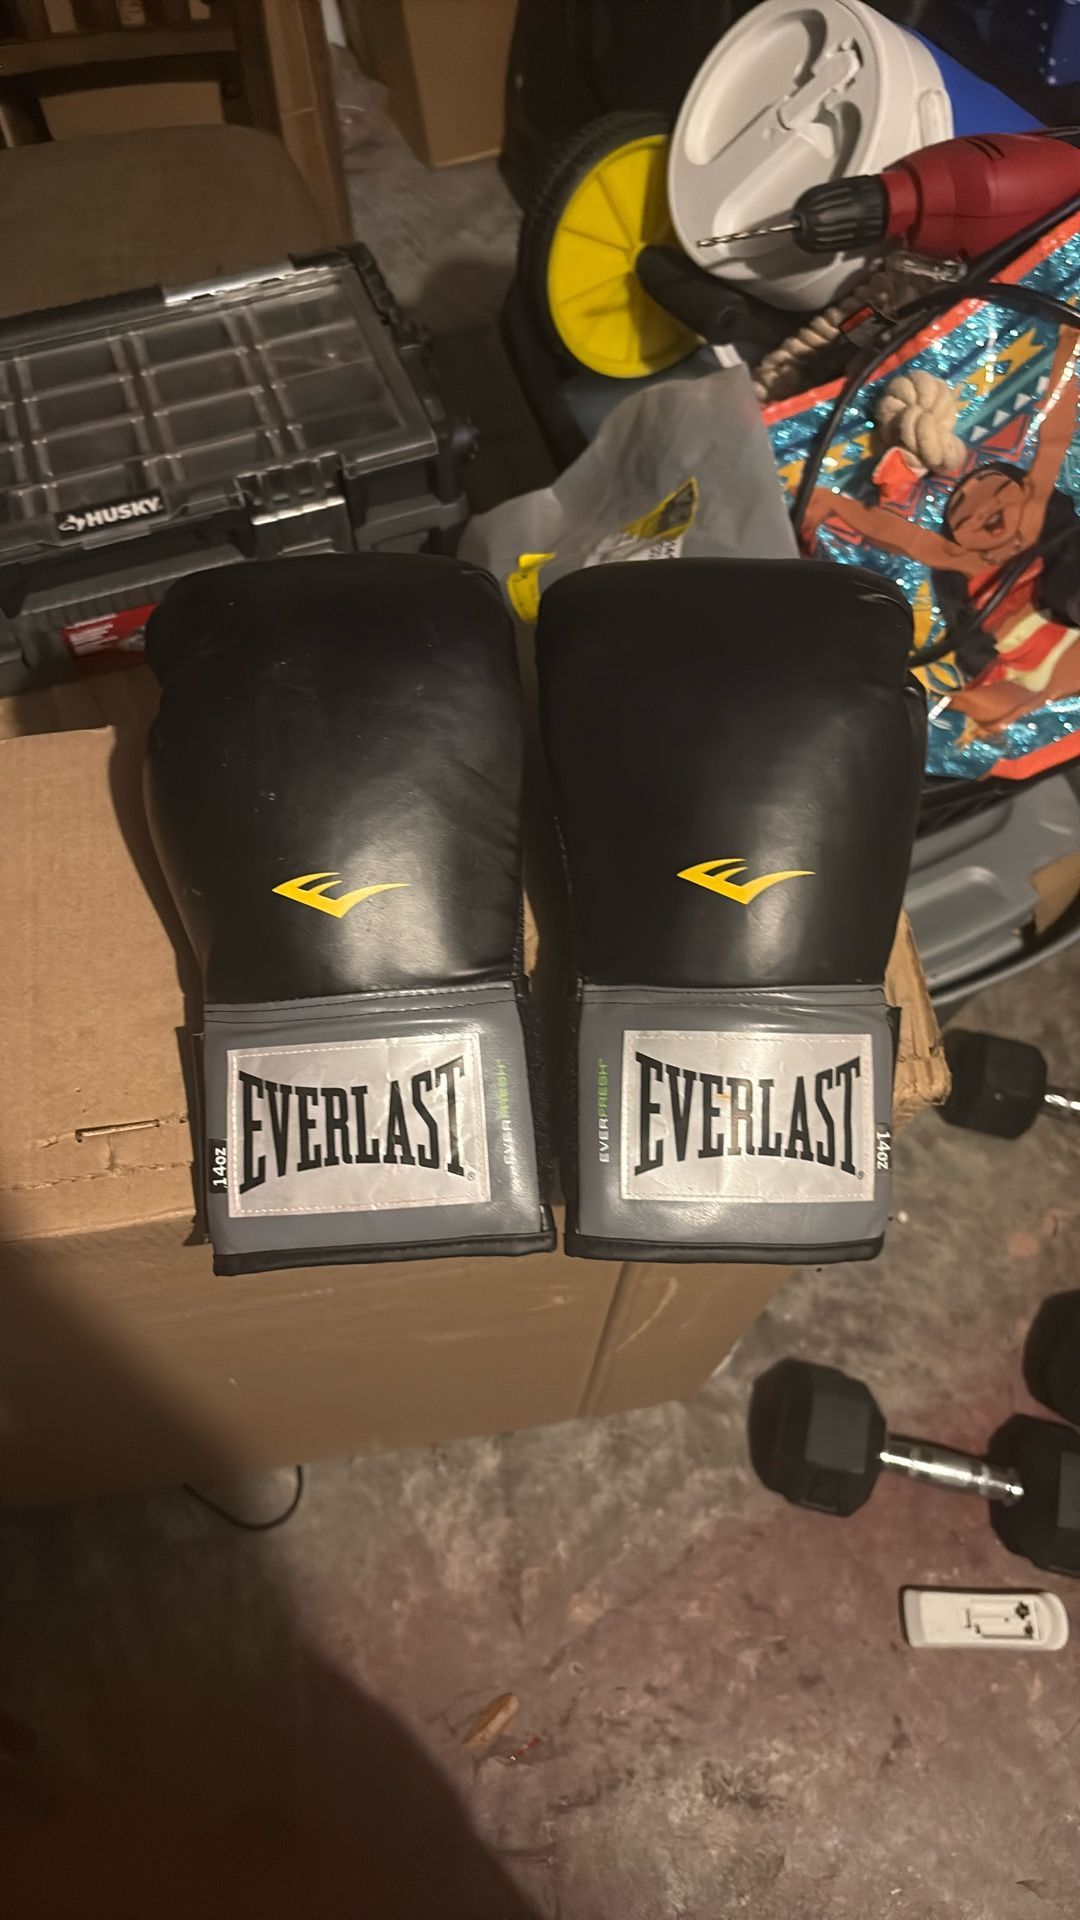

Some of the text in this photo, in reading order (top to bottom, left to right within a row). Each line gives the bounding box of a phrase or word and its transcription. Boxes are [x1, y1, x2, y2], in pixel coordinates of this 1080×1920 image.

[84, 496, 160, 528] HUSKY
[239, 1055, 466, 1194] EVERLAST
[635, 1051, 862, 1177] EVERLAST
[212, 1147, 227, 1187] 14oz
[876, 1130, 891, 1170] 14oz
